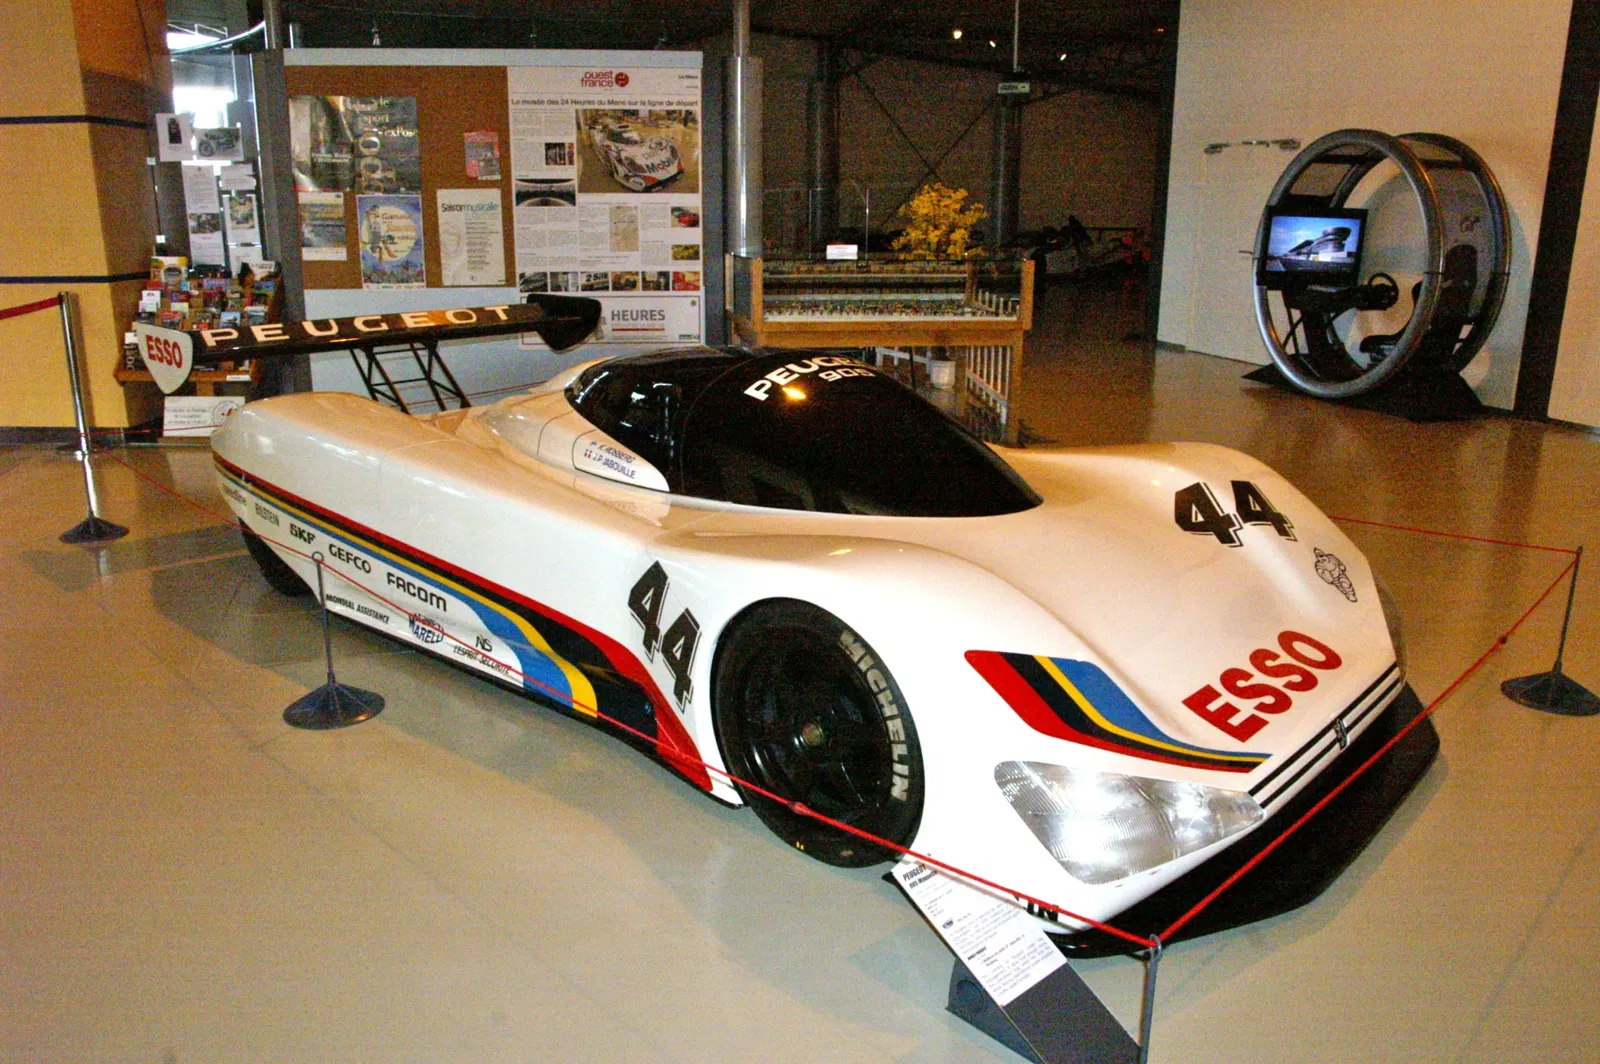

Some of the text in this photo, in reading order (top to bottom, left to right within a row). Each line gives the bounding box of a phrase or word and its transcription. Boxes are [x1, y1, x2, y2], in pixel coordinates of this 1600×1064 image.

[581, 77, 614, 88] france
[584, 70, 613, 79] ouest
[200, 305, 509, 347] PEUGEOT
[611, 309, 665, 321] HEURES
[145, 334, 183, 369] ESSO
[818, 368, 876, 382] 905
[1174, 479, 1298, 548] 44
[289, 523, 316, 545] SKF
[328, 543, 372, 574] GEFCO
[386, 572, 447, 612] FACOM
[325, 593, 356, 610] MONDIAL
[356, 604, 390, 625] ASSISTANCE
[627, 560, 701, 714] 44
[1181, 630, 1343, 743] ESSO
[838, 630, 909, 802] MICHELIN
[902, 863, 927, 882] PEUGEOT
